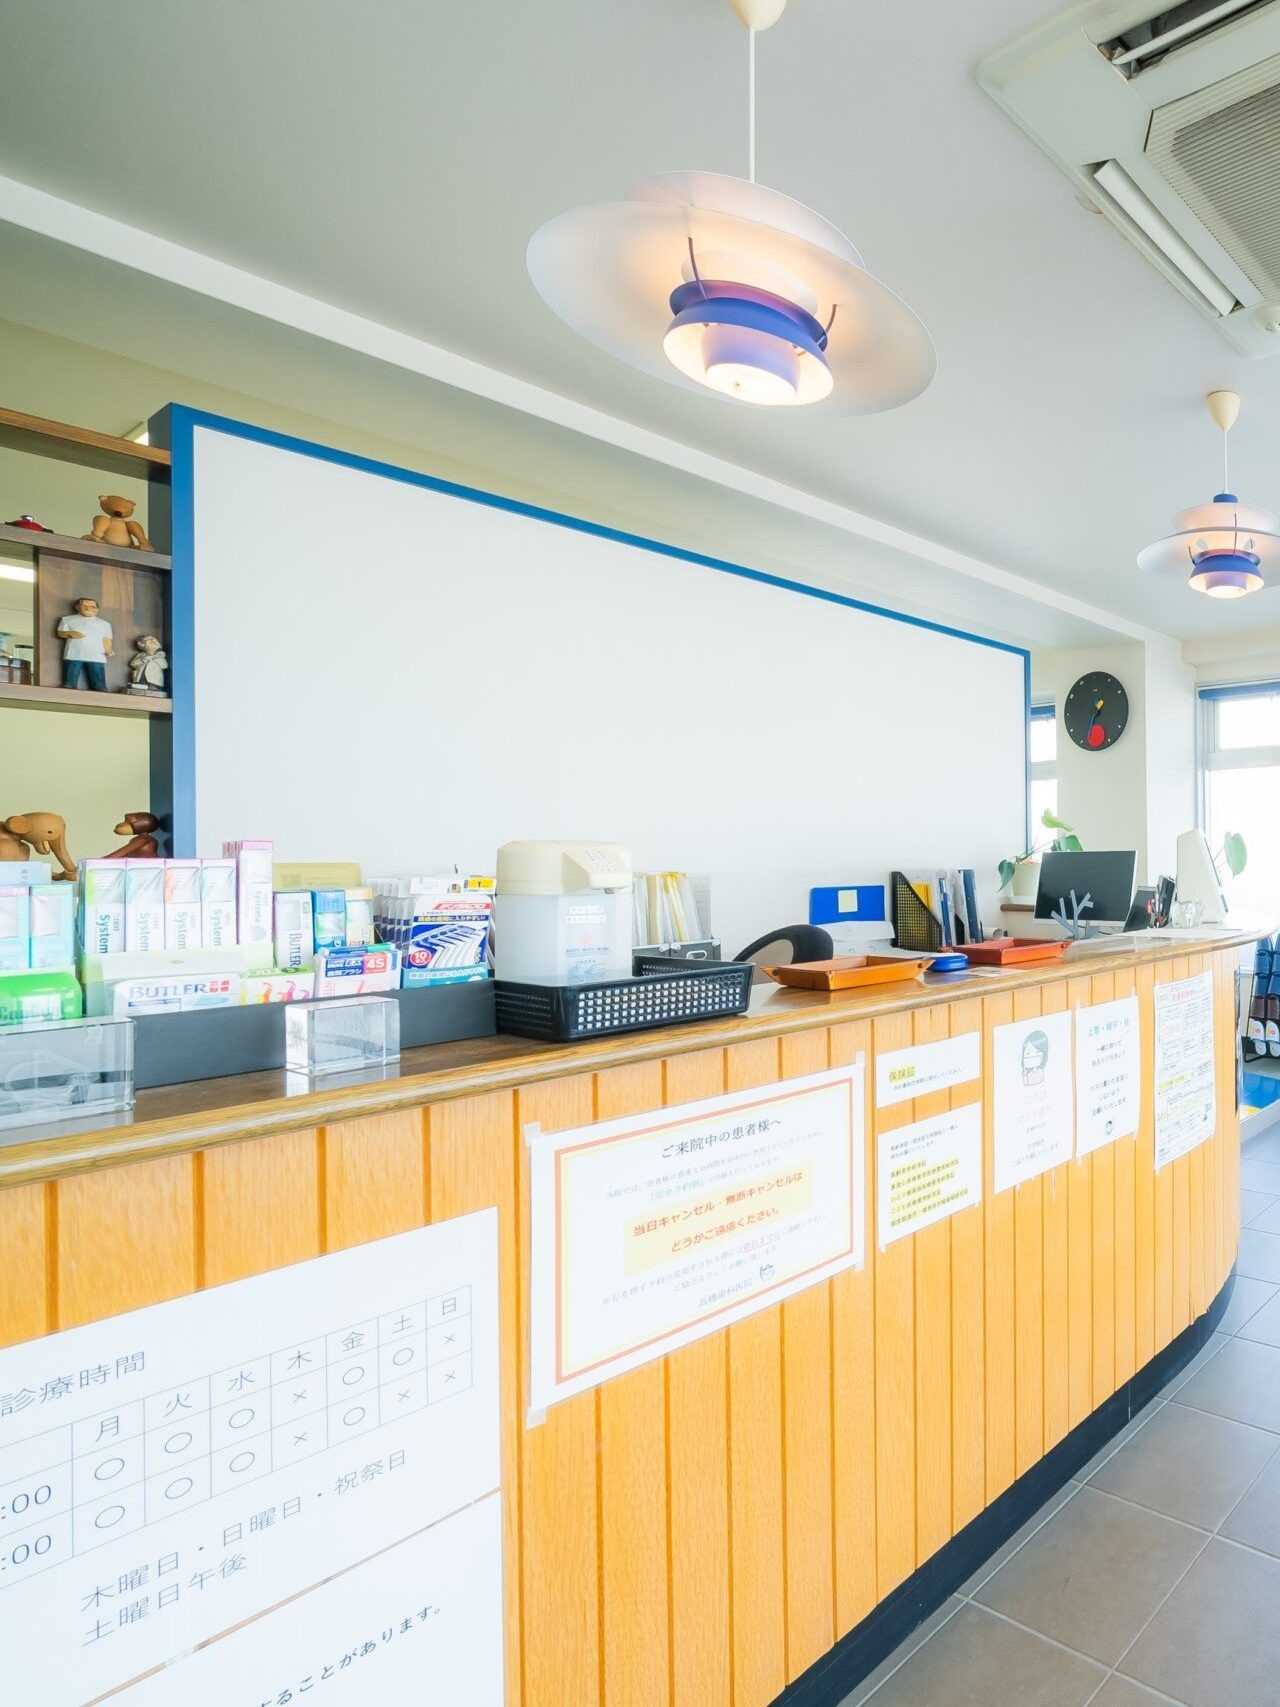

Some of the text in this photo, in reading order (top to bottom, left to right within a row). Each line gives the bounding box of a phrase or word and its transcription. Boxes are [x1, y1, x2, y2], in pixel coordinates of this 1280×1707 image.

[288, 933, 302, 967] BUTLER
[366, 956, 386, 969] 4S
[129, 983, 209, 1000] BUTLER
[661, 1118, 782, 1159] ご来院中の患者様へ
[633, 1171, 804, 1237] 当日キャンセル・無断キャンセルは
[1, 1351, 145, 1417] 診療時間
[95, 1297, 457, 1441] 月 火 水 木 金 土 日
[81, 1449, 406, 1611] 木曜日・日曜日・祝祭日
[81, 1553, 248, 1647] 土曜日午後
